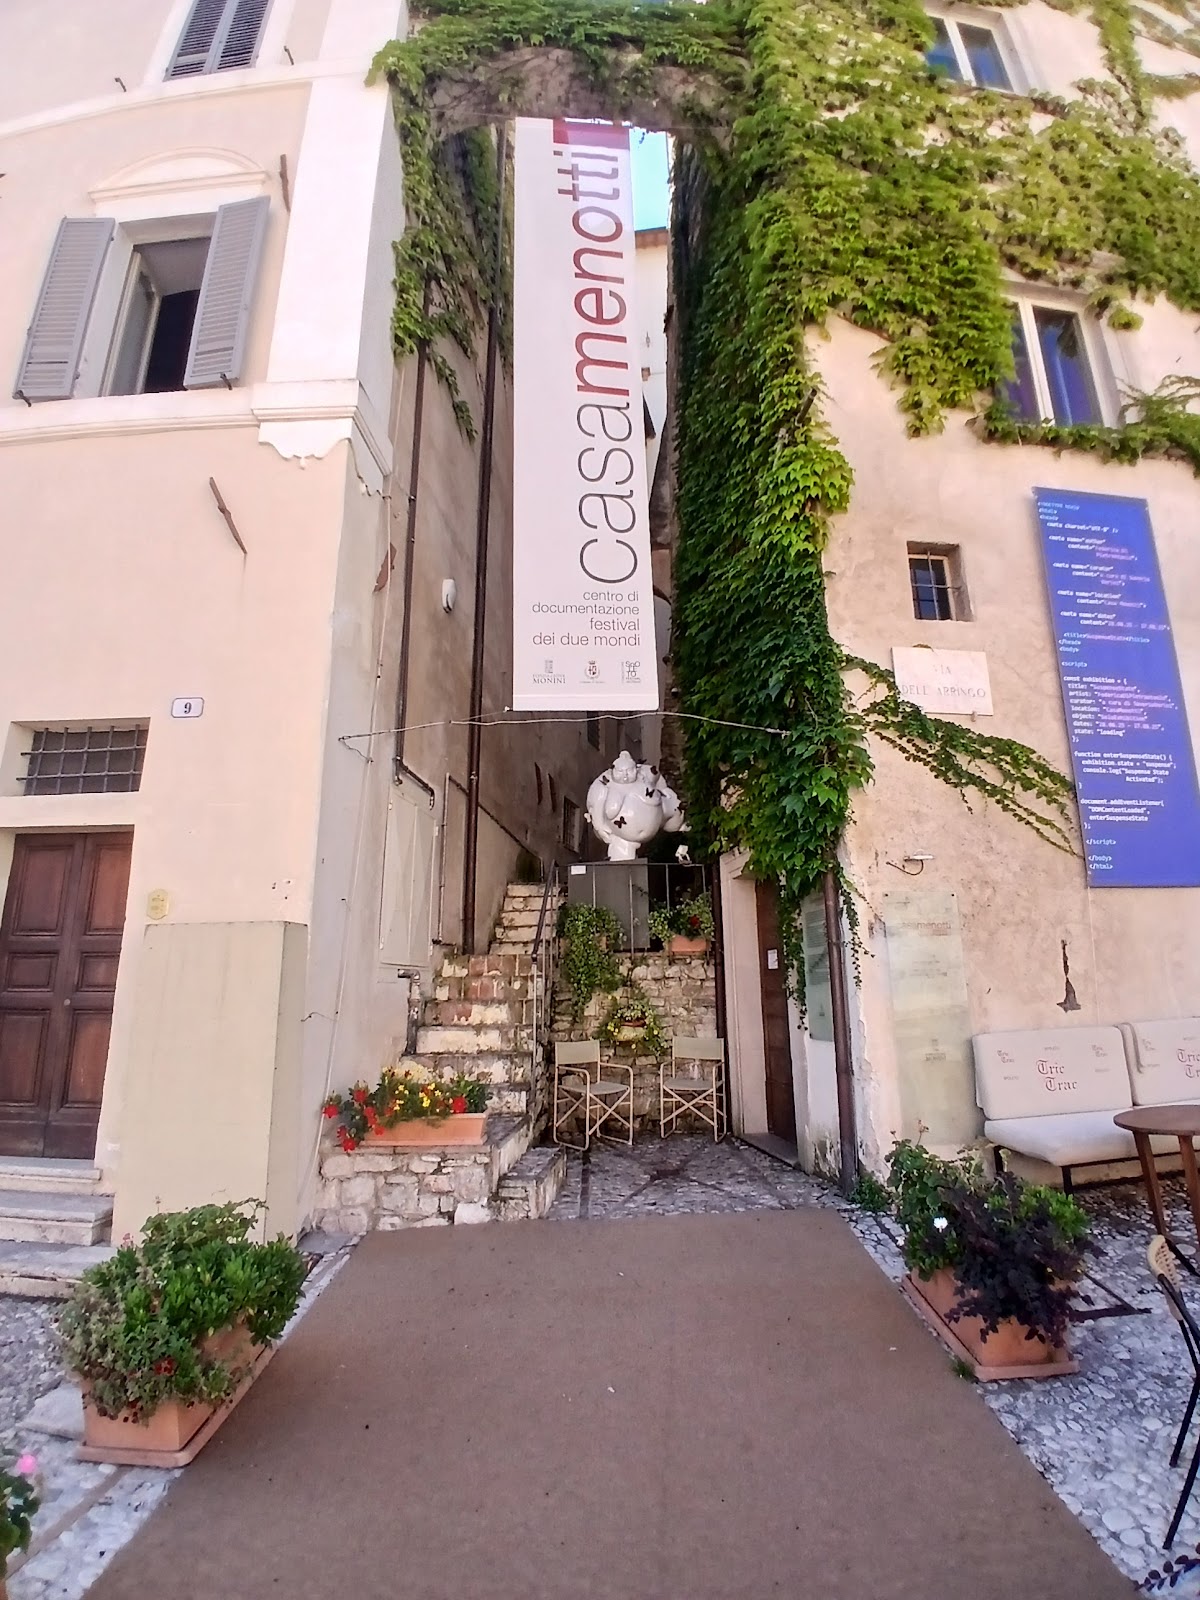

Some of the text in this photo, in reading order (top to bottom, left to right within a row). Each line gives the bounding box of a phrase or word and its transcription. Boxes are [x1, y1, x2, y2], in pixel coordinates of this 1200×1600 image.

[554, 151, 638, 583] casamenotti
[583, 591, 639, 602] centro di
[532, 603, 640, 615] documentazione
[590, 618, 640, 631] festival
[532, 632, 640, 646] dei due mondi
[184, 702, 192, 714] 9
[1036, 1060, 1064, 1074] Tric
[1046, 1076, 1078, 1091] Trac
